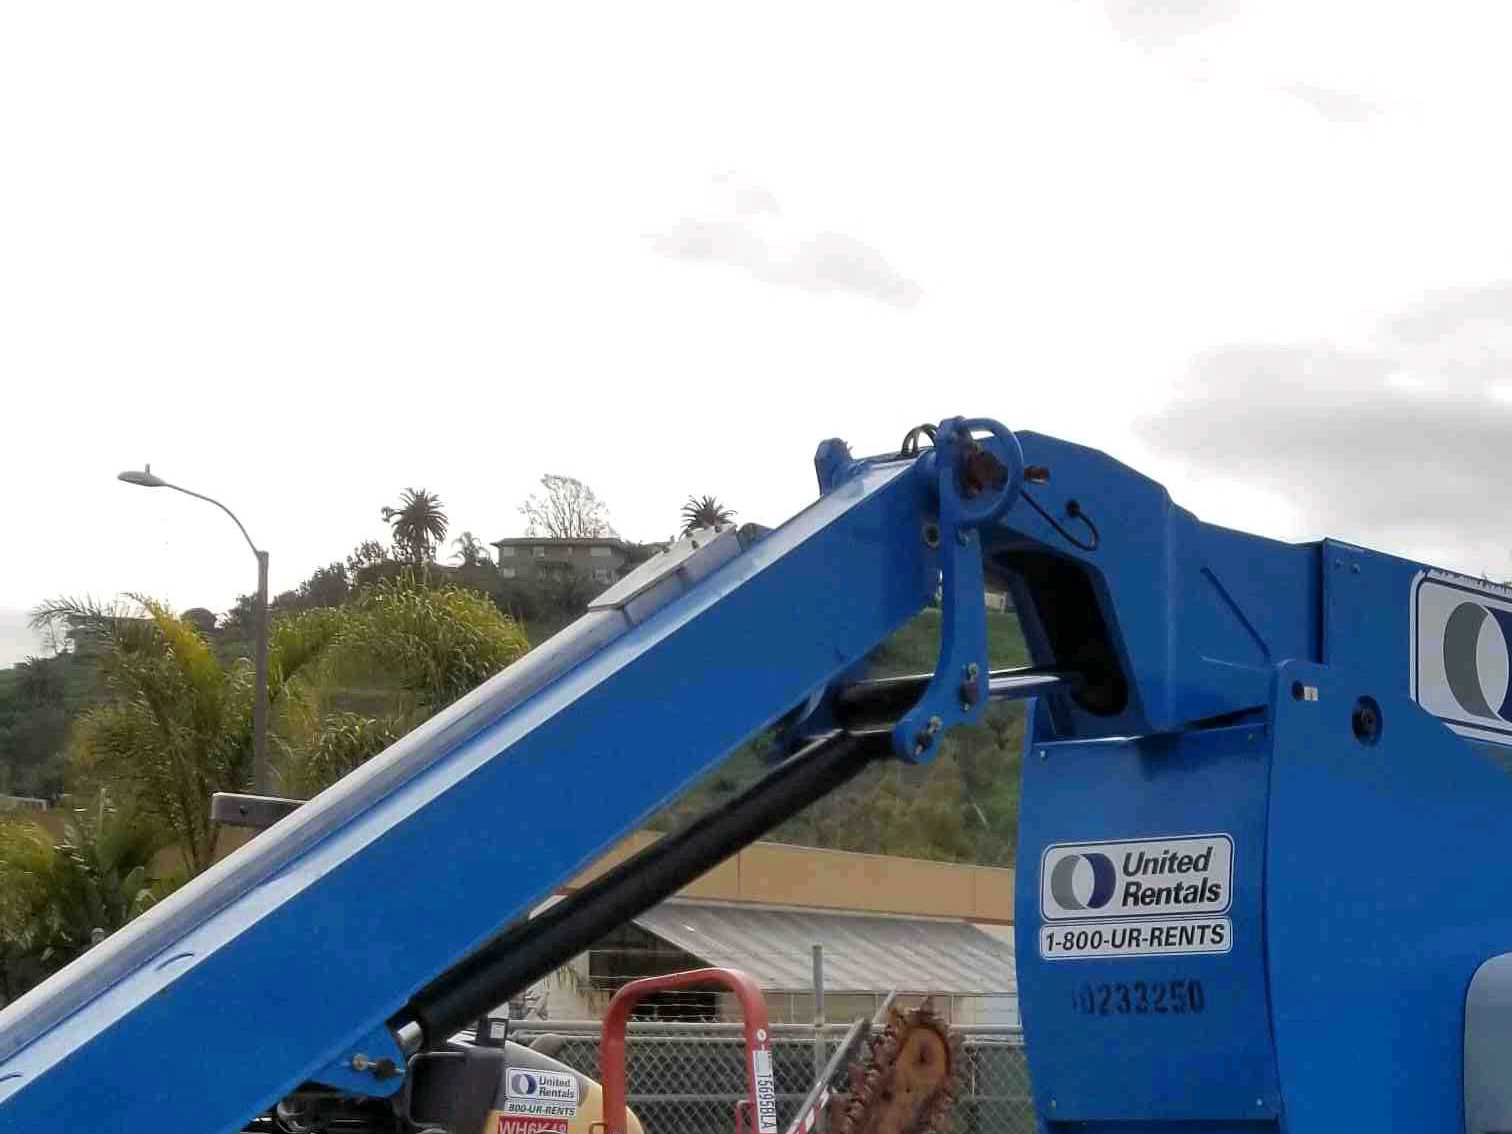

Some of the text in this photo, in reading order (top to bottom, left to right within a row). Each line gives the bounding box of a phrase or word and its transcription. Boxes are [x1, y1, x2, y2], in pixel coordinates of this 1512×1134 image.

[1122, 846, 1213, 877] United
[1121, 877, 1222, 907] Rentals
[1046, 923, 1225, 951] 1-800-UR-RENTS
[539, 1076, 571, 1086] United
[539, 1087, 575, 1098] Rentals
